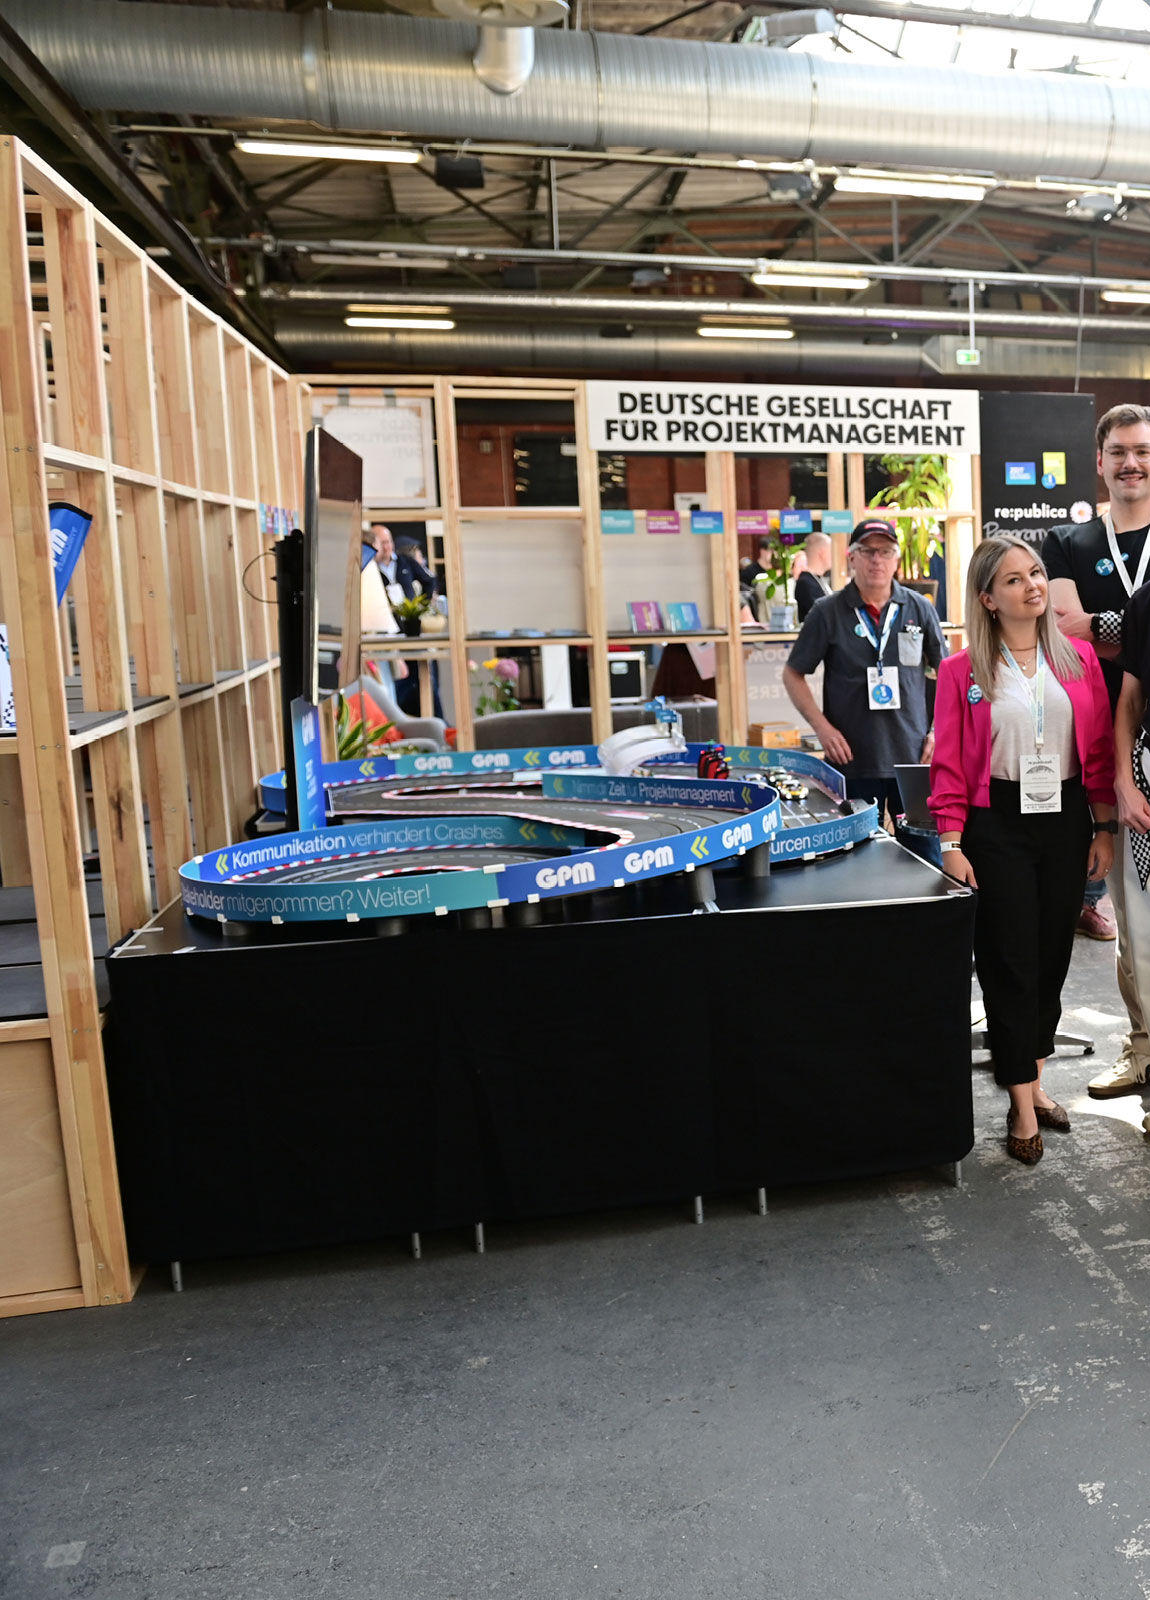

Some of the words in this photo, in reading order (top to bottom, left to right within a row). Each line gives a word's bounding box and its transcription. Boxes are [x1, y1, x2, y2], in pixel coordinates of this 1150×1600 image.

[619, 392, 759, 416] DEUTSCHE
[766, 395, 952, 420] GESELLSCHAFT
[605, 418, 659, 441] FÜR
[666, 420, 966, 446] PROJEKTMANAGEMENT
[994, 502, 1068, 522] re:publica
[414, 756, 453, 770] GPM
[472, 753, 510, 768] GPM
[548, 749, 586, 765] GPM
[608, 780, 627, 797] Zeit
[639, 782, 737, 803] Projektmanagement
[762, 809, 778, 834] GPM
[231, 834, 347, 870] Kommunikation
[347, 825, 432, 847] verhindert
[721, 822, 753, 849] GPM
[812, 827, 834, 847] sind
[623, 845, 675, 874] GPM
[535, 861, 596, 890] GPM
[226, 889, 354, 917] mitgenommen?
[356, 883, 431, 910] Weiter!
